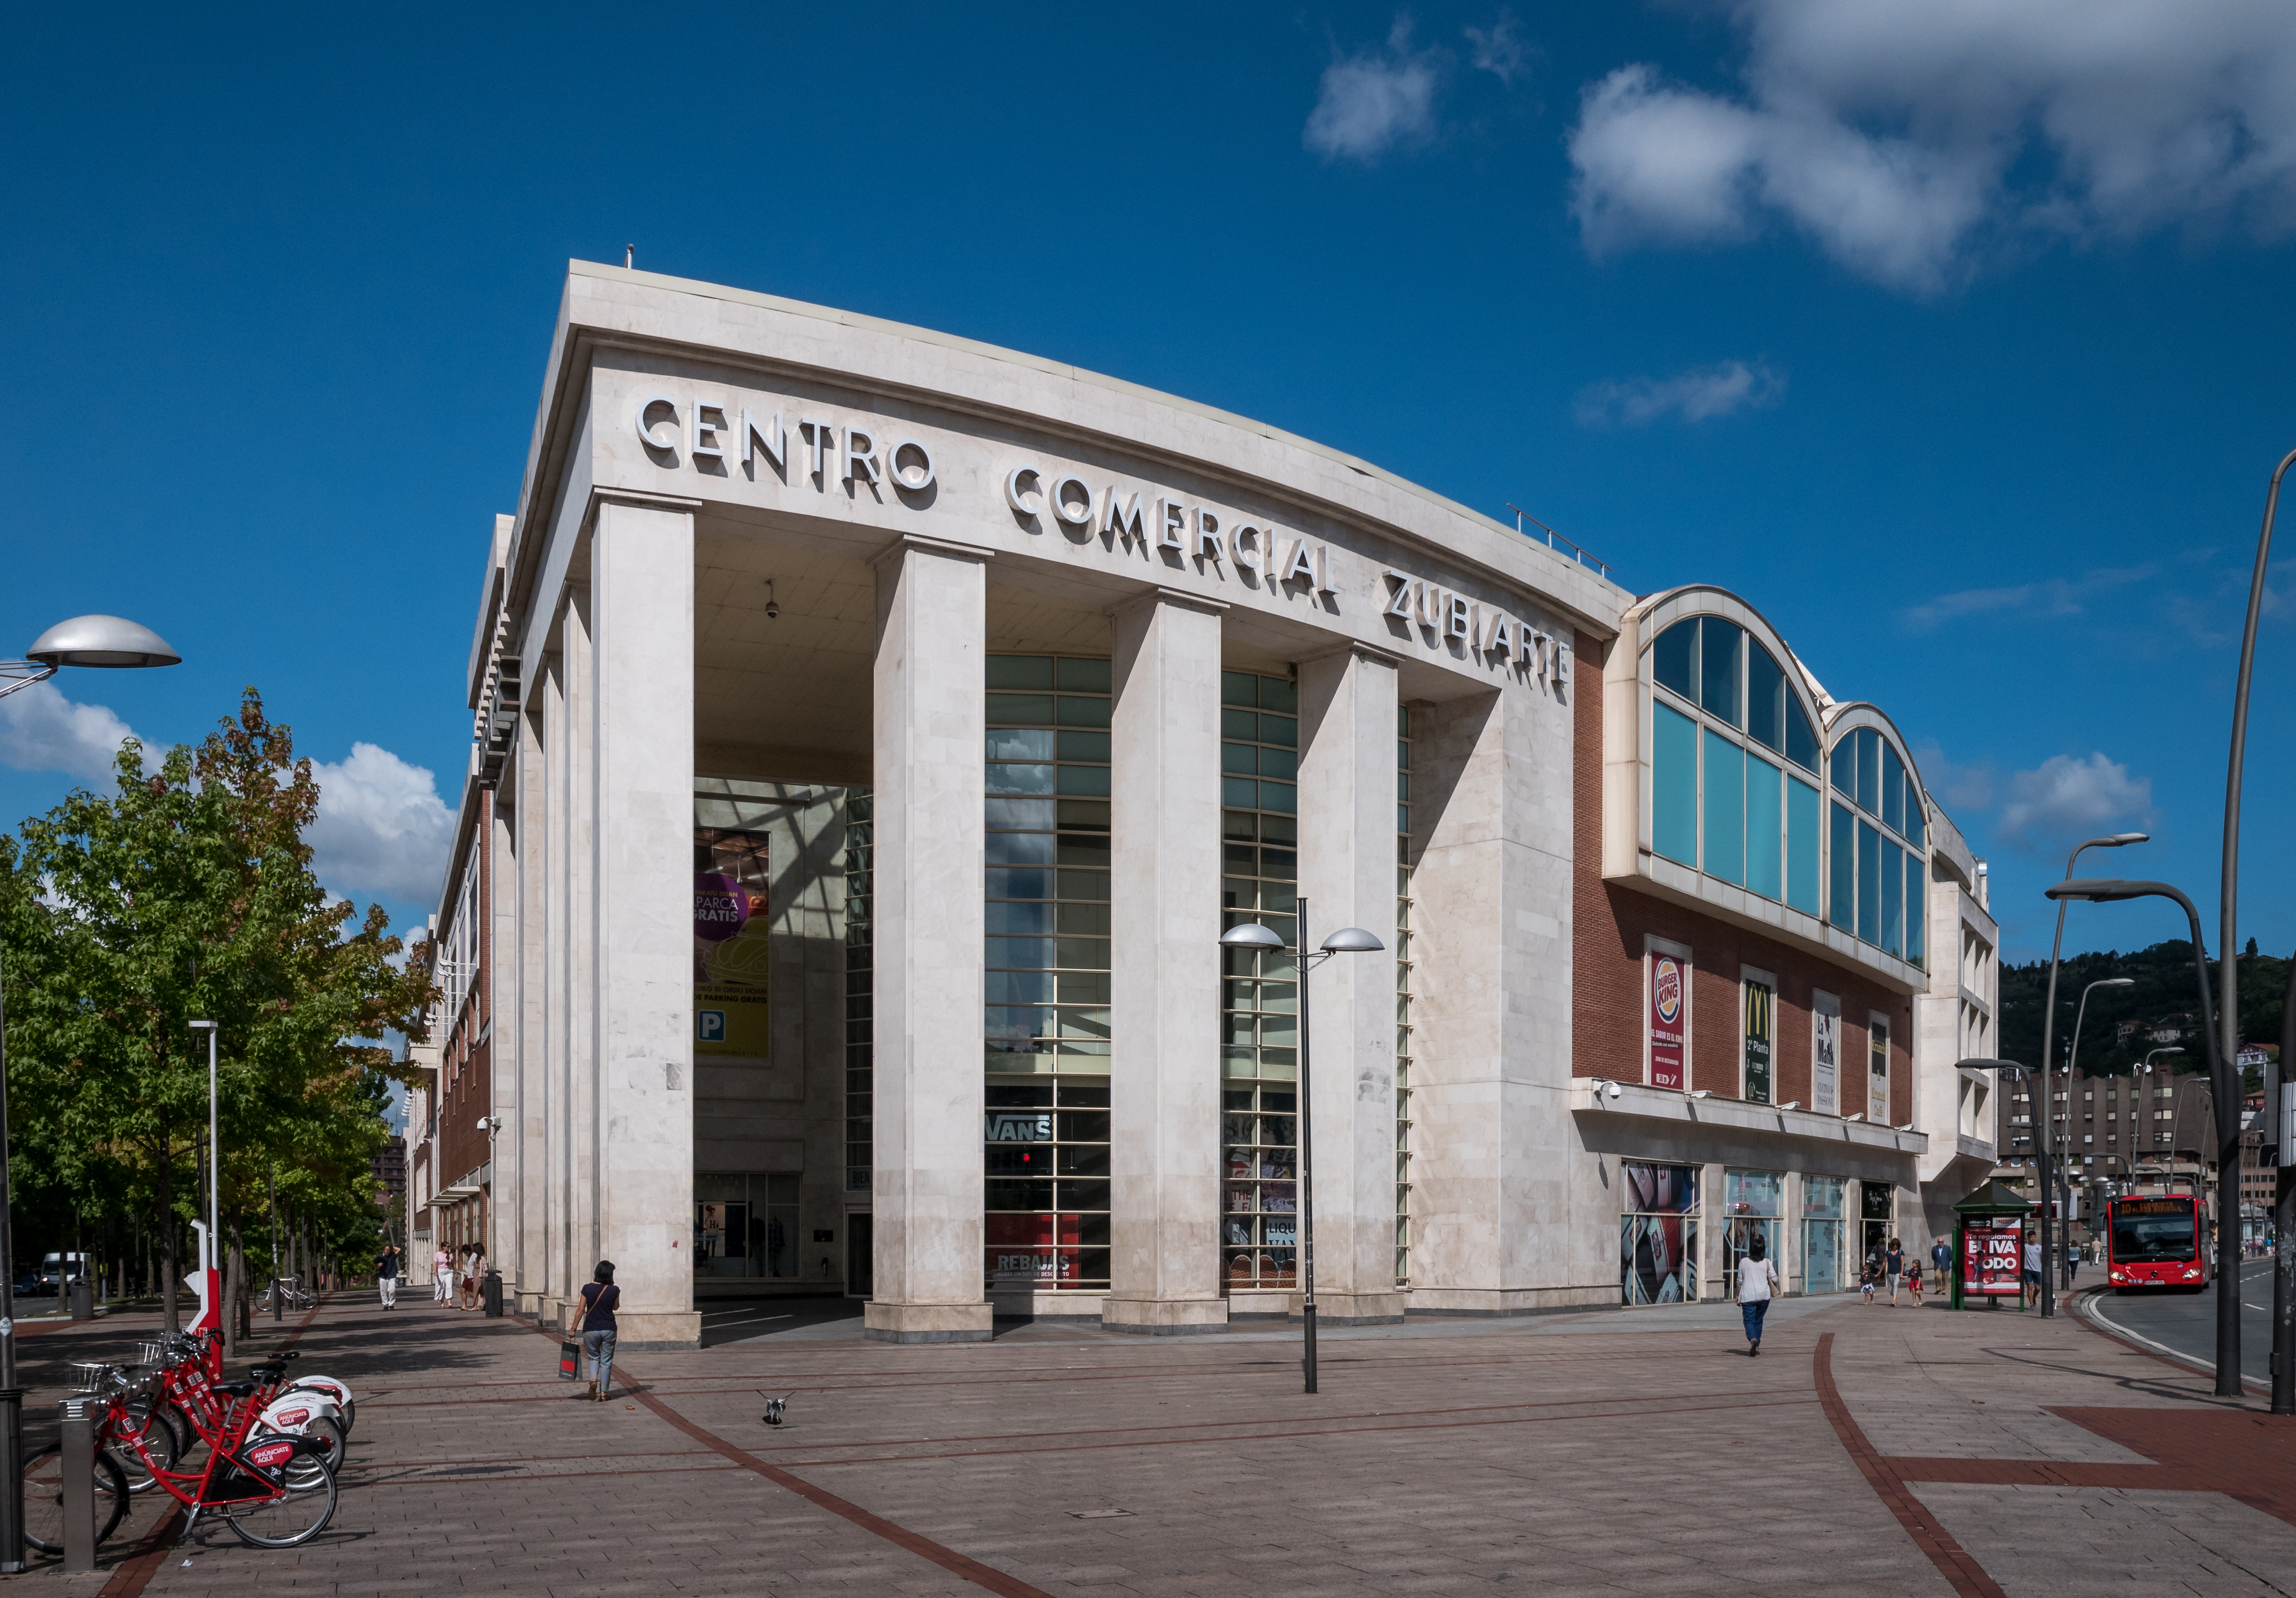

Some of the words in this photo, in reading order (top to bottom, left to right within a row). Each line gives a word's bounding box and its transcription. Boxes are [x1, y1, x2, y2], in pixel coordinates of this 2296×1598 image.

[636, 393, 935, 490] CENTRO
[1004, 464, 1340, 595] COMERCIAL
[1382, 570, 1570, 683] ZUBIARTE
[694, 896, 738, 910] PARCA
[1658, 973, 1677, 990] BURGER
[1659, 983, 1677, 1006] KING
[702, 1013, 721, 1037] P
[1818, 1016, 1823, 1035] La
[1667, 1032, 1671, 1040] ES
[1671, 1033, 1675, 1041] EL
[1753, 1041, 1769, 1054] Planta
[985, 1115, 1051, 1140] VANS
[853, 1171, 869, 1183] BIEN
[1231, 1189, 1252, 1201] THE
[2122, 1204, 2131, 1213] 10
[709, 1220, 716, 1228] H
[1969, 1240, 1985, 1254] EL
[998, 1255, 1070, 1270] REBAJAS
[279, 1411, 307, 1421] ANÚNCIATE
[123, 1419, 135, 1431] 638
[255, 1446, 290, 1459] ANÚNCIATE
